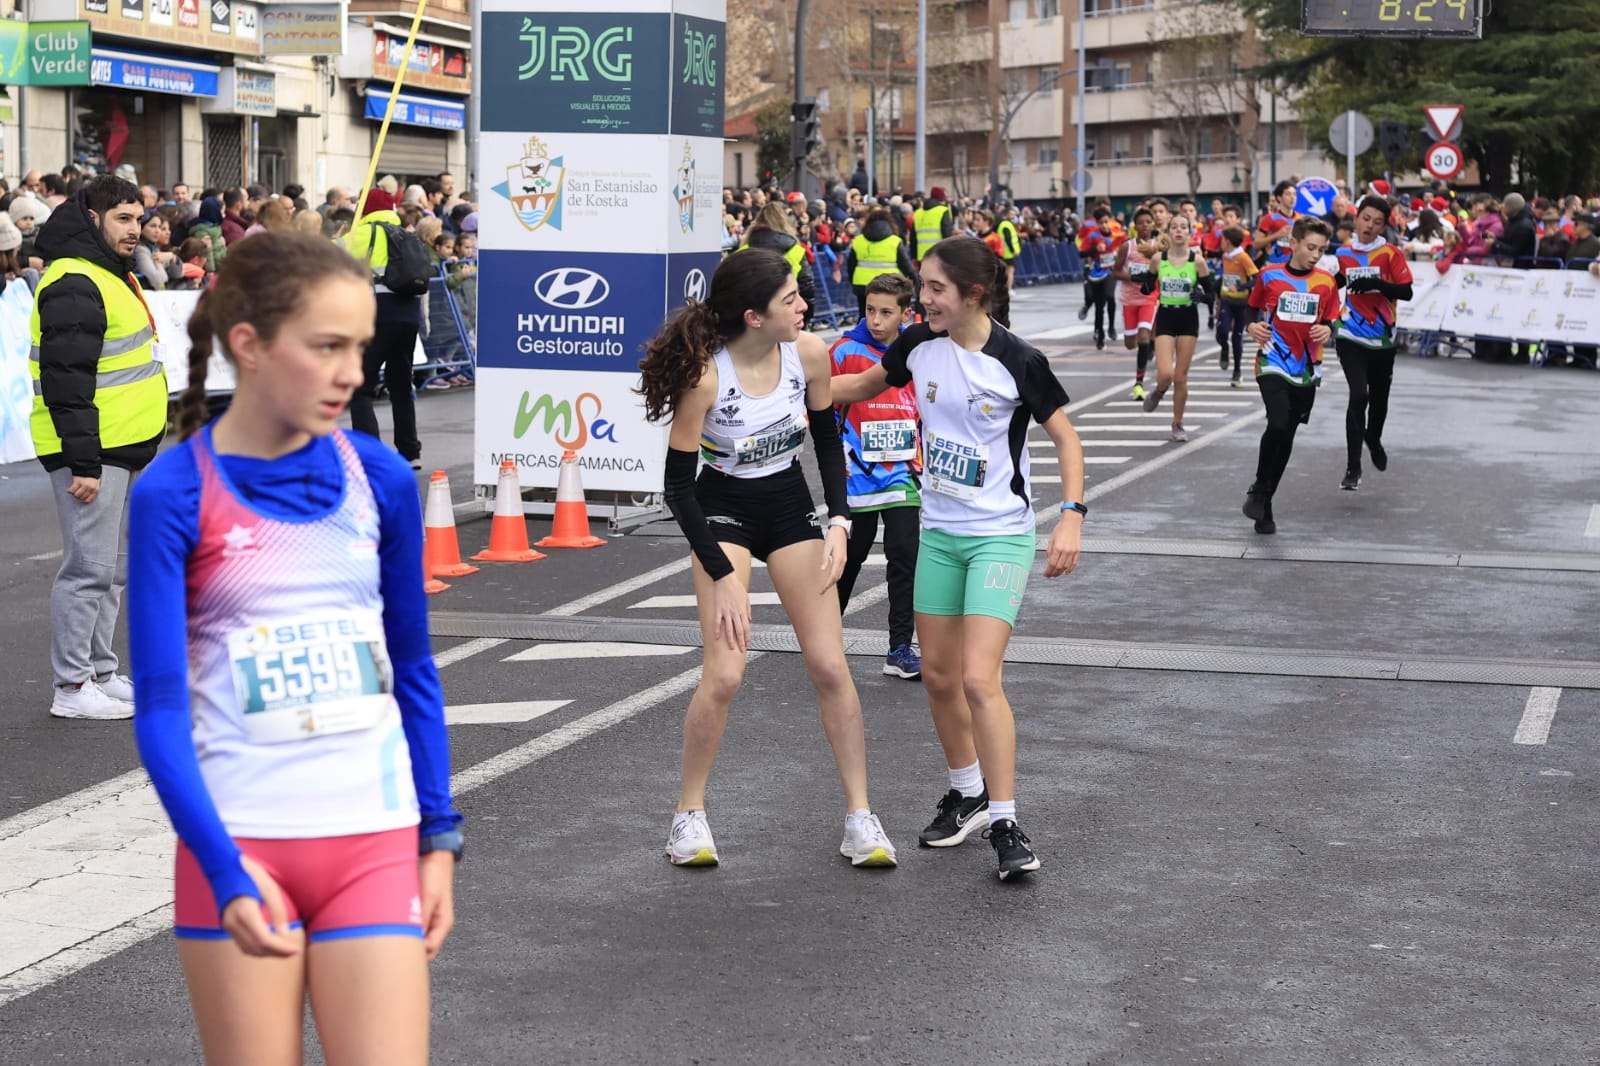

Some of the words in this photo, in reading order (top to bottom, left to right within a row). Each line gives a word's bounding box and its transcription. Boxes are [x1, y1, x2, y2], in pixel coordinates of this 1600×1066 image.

[34, 31, 79, 52] Club
[31, 53, 87, 74] Verde
[1434, 155, 1453, 167] 30
[567, 179, 590, 192] San
[594, 180, 658, 194] Estanislao
[567, 194, 582, 206] de
[586, 195, 628, 208] Kostka
[518, 314, 624, 334] HYUNDAI
[517, 336, 623, 356] Gestorauto
[877, 421, 910, 430] SETEL
[869, 430, 906, 449] 5584
[935, 437, 981, 458] SETEL
[275, 619, 366, 644] SETEL
[254, 640, 363, 702] 5599
